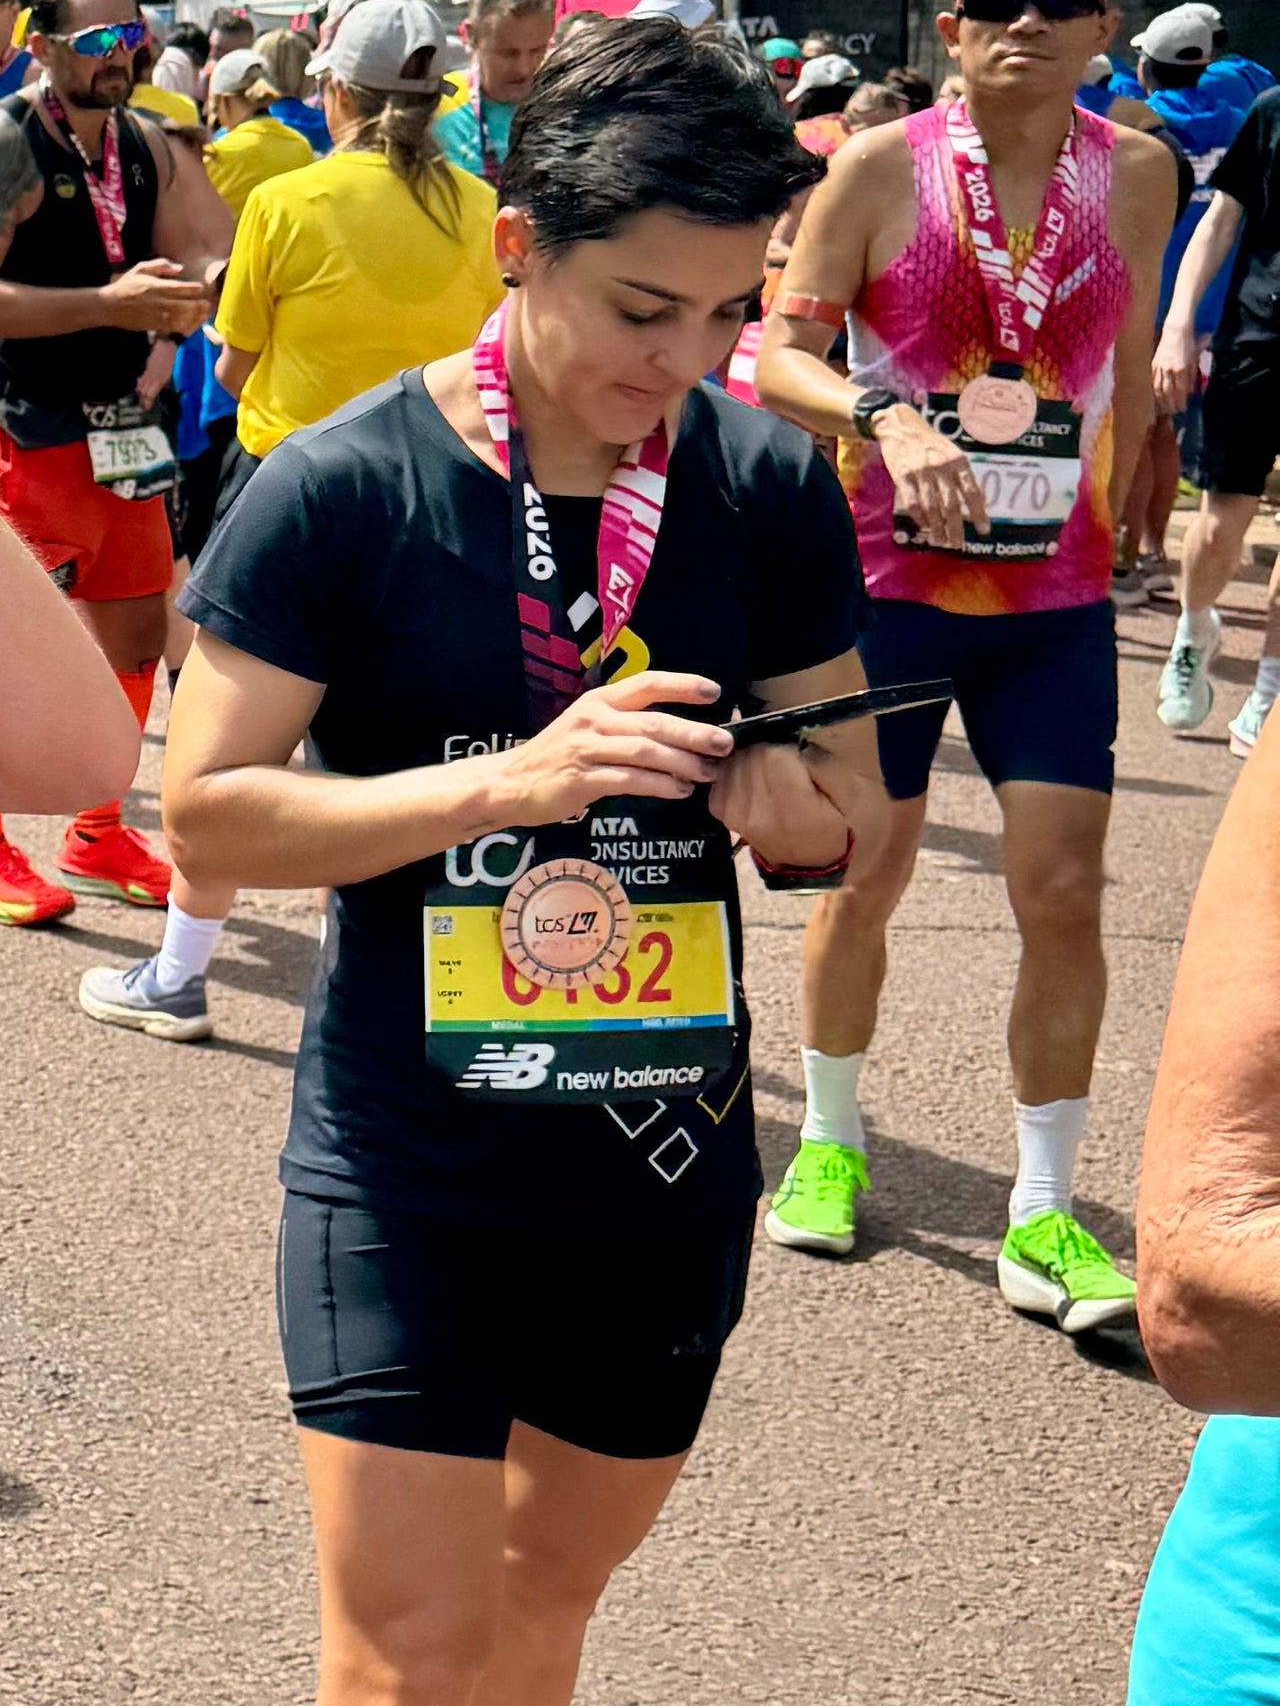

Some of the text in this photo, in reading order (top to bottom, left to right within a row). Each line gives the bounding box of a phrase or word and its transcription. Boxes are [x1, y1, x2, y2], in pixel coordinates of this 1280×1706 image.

[964, 168, 995, 223] 2026
[981, 470, 1052, 511] 070
[590, 817, 639, 836] ATA
[445, 833, 536, 887] tc
[590, 840, 705, 862] ONSULTANCY
[608, 865, 670, 885] VICES
[535, 915, 564, 933] tcs
[556, 1065, 705, 1091] new balance
